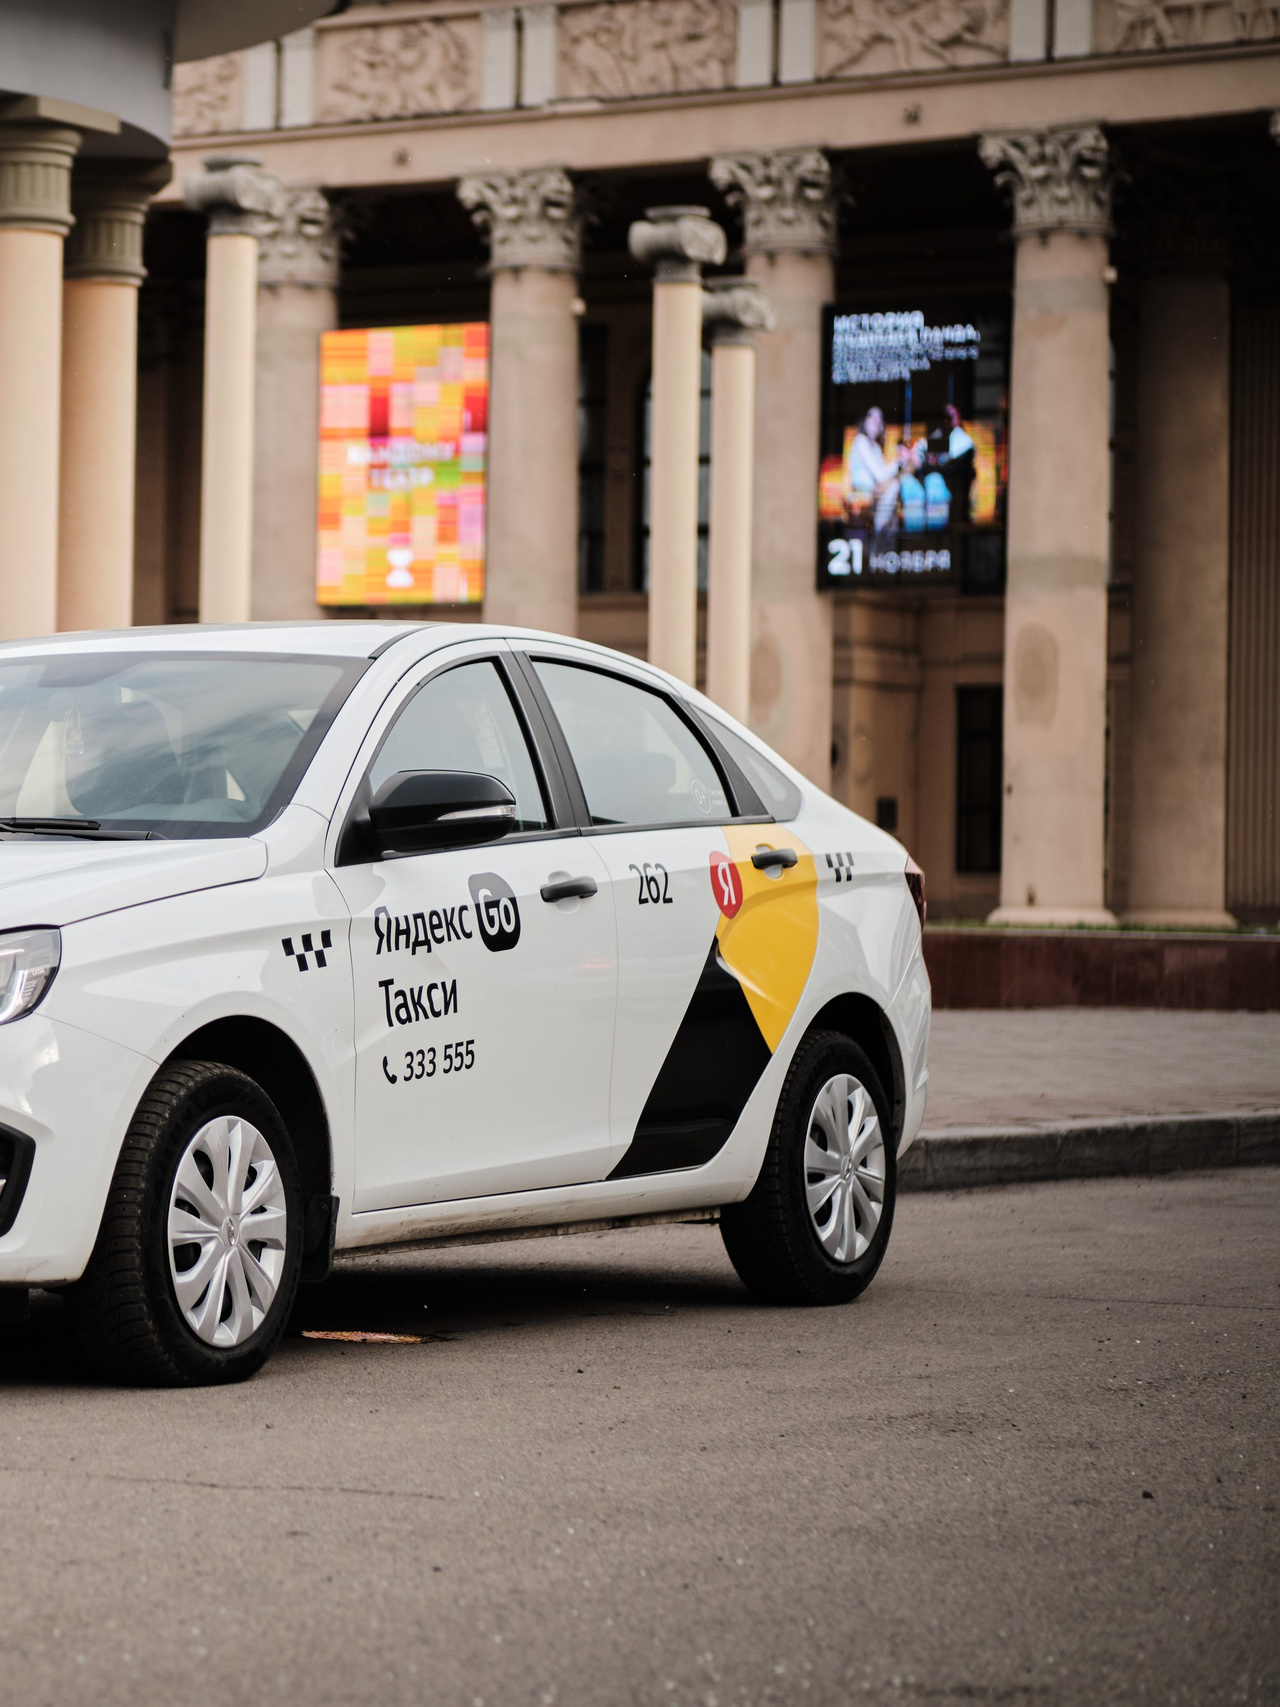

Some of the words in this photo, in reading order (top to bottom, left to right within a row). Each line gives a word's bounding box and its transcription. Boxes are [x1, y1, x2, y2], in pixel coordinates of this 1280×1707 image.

[827, 538, 863, 576] 21
[869, 549, 951, 573] НОЯБРЯ
[628, 862, 673, 905] 262
[717, 861, 736, 906] Я
[374, 906, 473, 956] Яндекс
[478, 888, 516, 936] Go
[378, 978, 458, 1027] Такси
[403, 1047, 437, 1081] 333
[443, 1039, 475, 1074] 555
